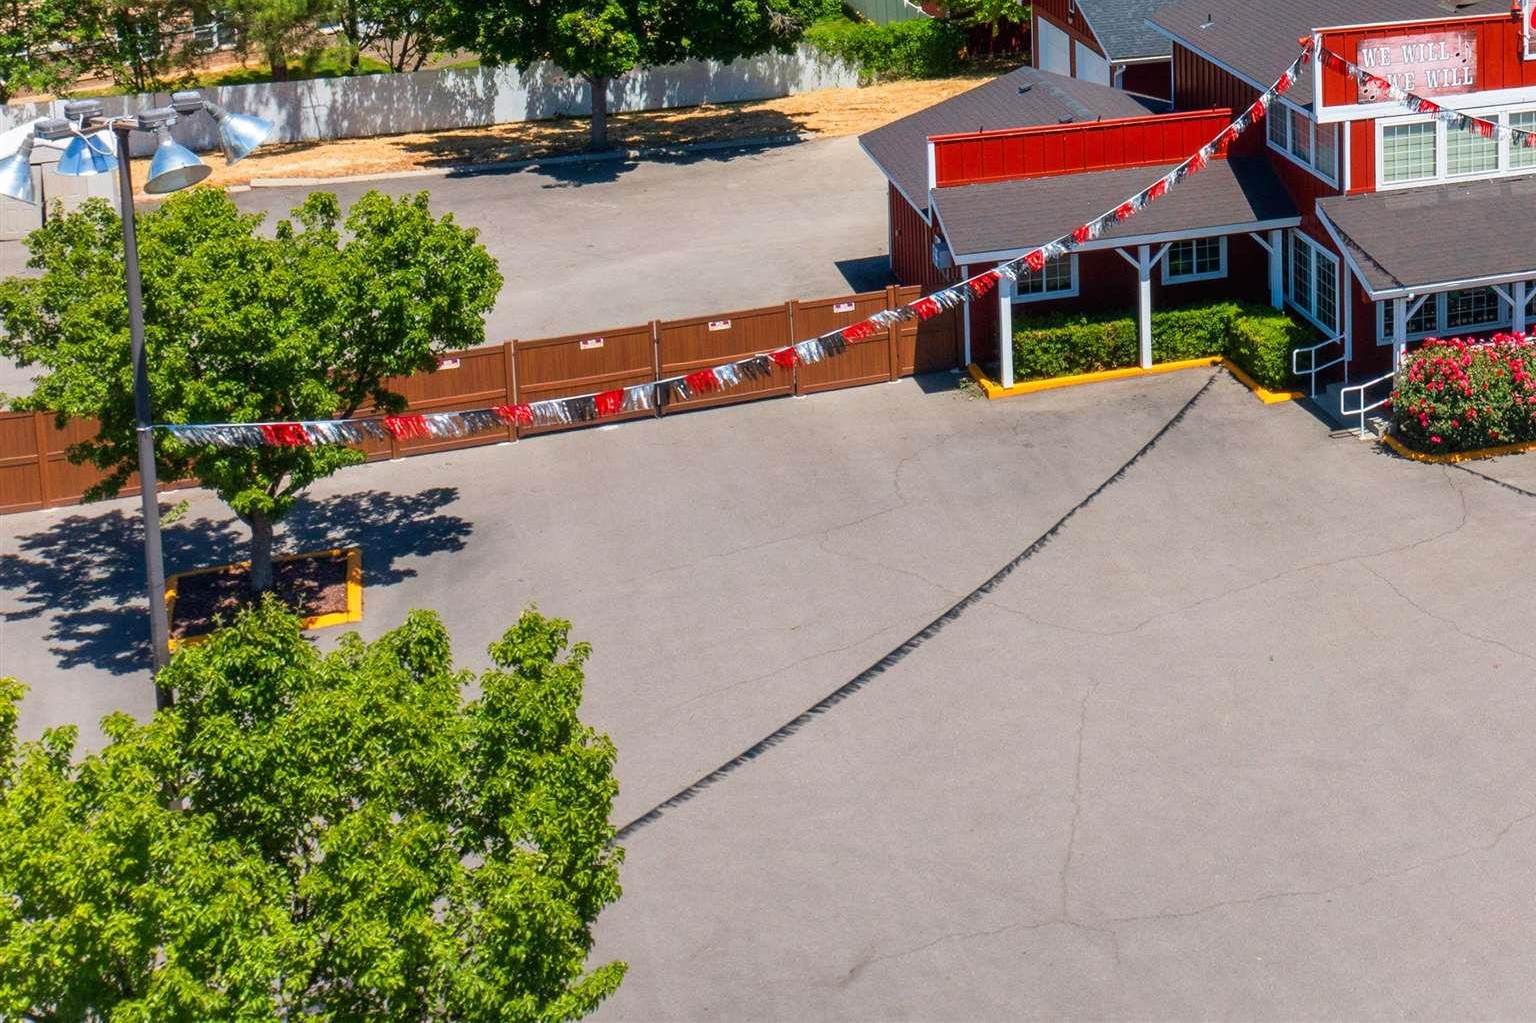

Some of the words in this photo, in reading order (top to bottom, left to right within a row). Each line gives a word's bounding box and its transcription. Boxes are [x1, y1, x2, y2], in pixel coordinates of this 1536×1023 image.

[1362, 47, 1392, 68] WE
[1402, 41, 1450, 64] WILL
[1386, 72, 1416, 91] WE
[1425, 66, 1473, 89] WILL
